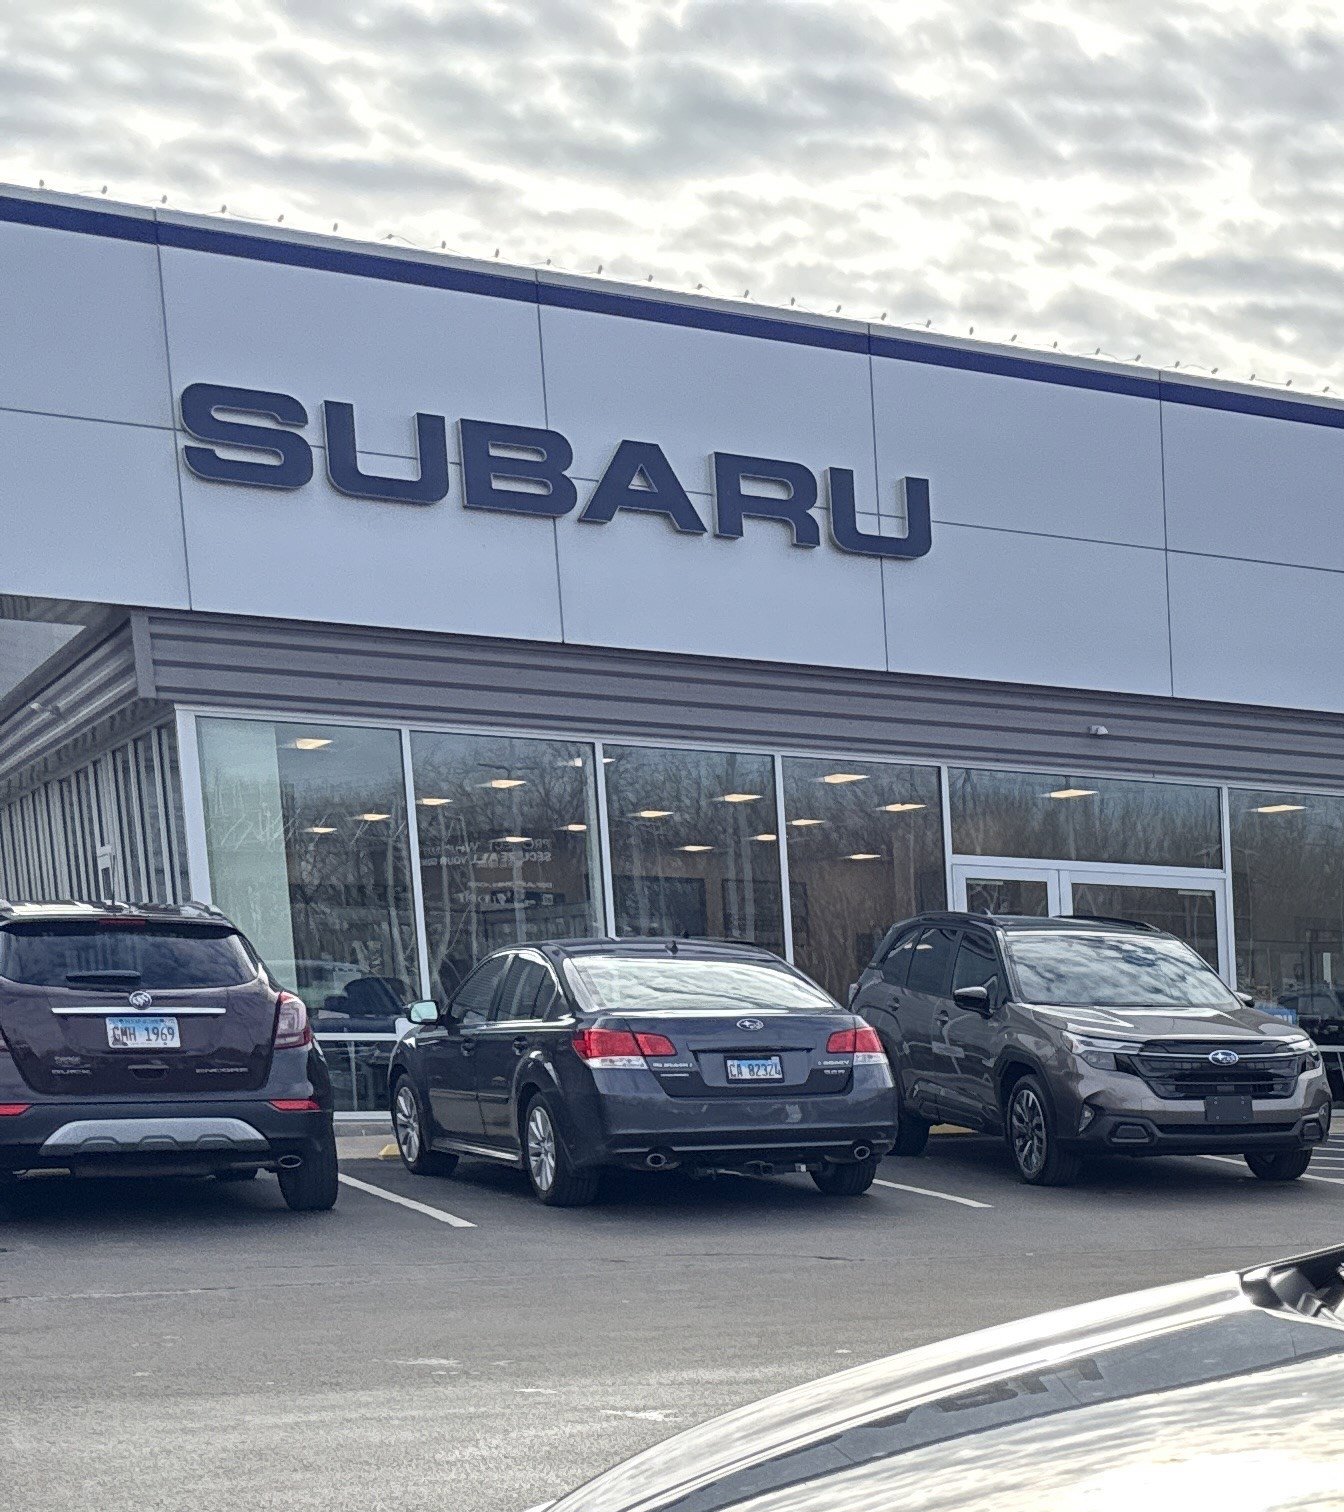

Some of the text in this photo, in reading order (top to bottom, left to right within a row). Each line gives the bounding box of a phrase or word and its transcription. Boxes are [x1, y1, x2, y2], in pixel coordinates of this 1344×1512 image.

[180, 382, 933, 561] SUBARU
[112, 1026, 175, 1042] GMH 1969
